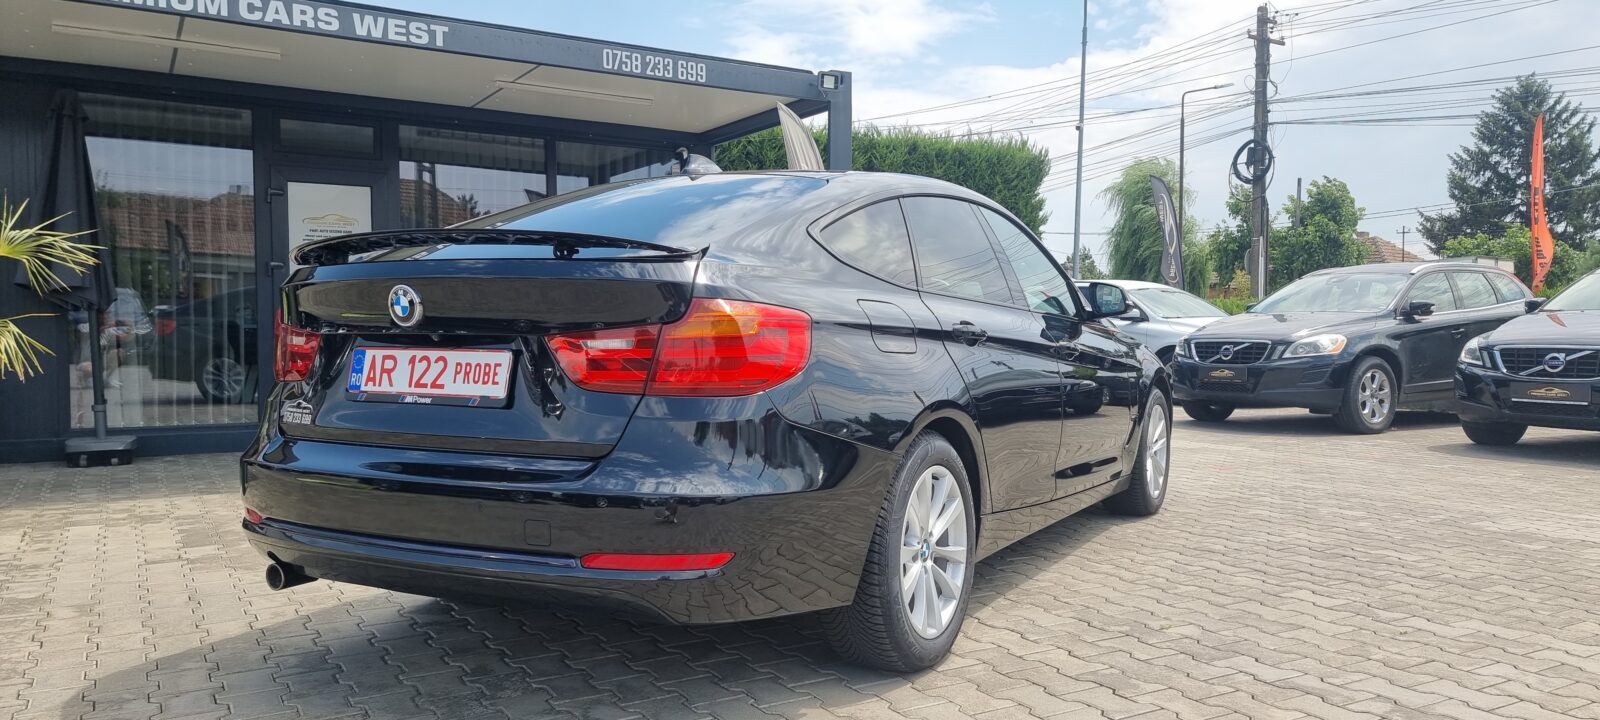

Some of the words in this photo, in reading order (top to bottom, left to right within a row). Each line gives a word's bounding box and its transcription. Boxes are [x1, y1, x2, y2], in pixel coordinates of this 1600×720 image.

[238, 0, 340, 31] CARS
[352, 12, 449, 47] WEST
[603, 49, 642, 73] 0758
[646, 56, 673, 78] 233
[678, 61, 706, 83] 699
[350, 372, 362, 386] RO
[363, 354, 398, 388] AR
[407, 354, 449, 390] 122
[452, 361, 502, 386] PROBE
